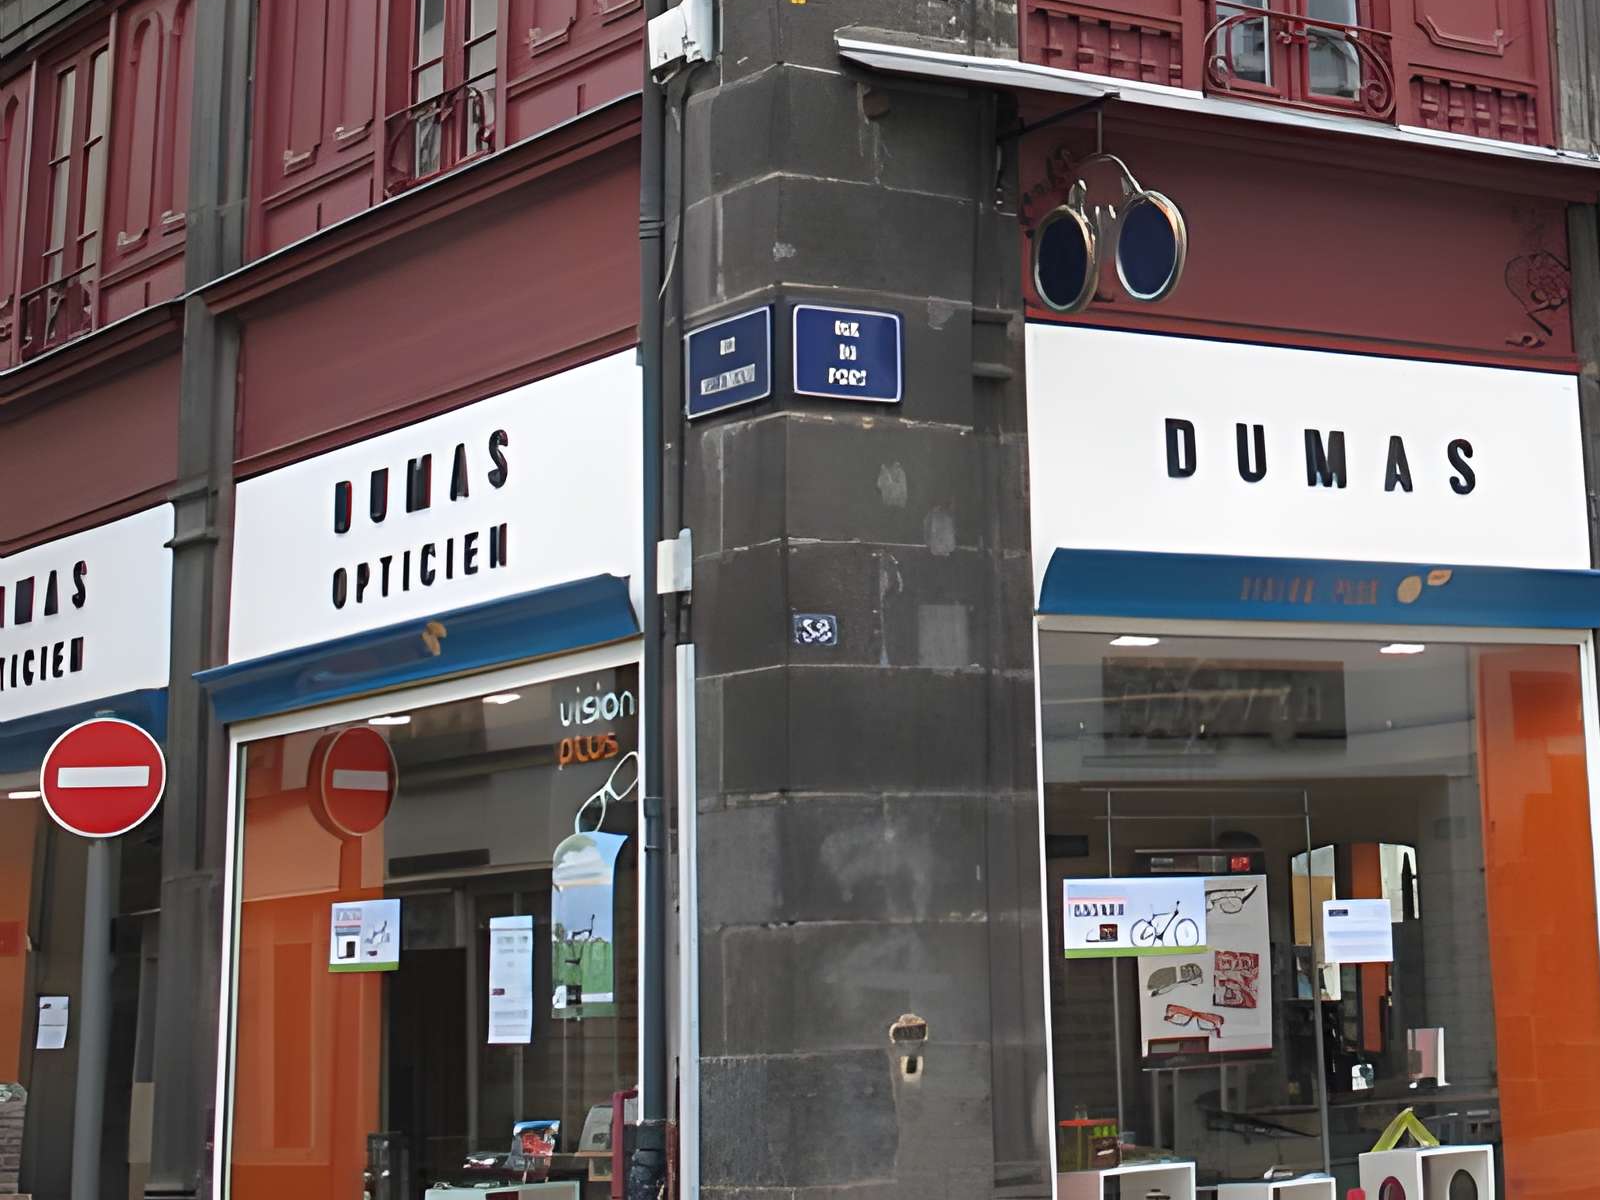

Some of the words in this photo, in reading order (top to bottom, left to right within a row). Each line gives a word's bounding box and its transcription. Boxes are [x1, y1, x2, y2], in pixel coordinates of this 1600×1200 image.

[334, 429, 509, 534] DUMAS
[1165, 417, 1477, 495] DUMAS
[0, 560, 88, 629] MAS
[332, 523, 508, 609] OPTICIEN
[560, 681, 636, 727] vision
